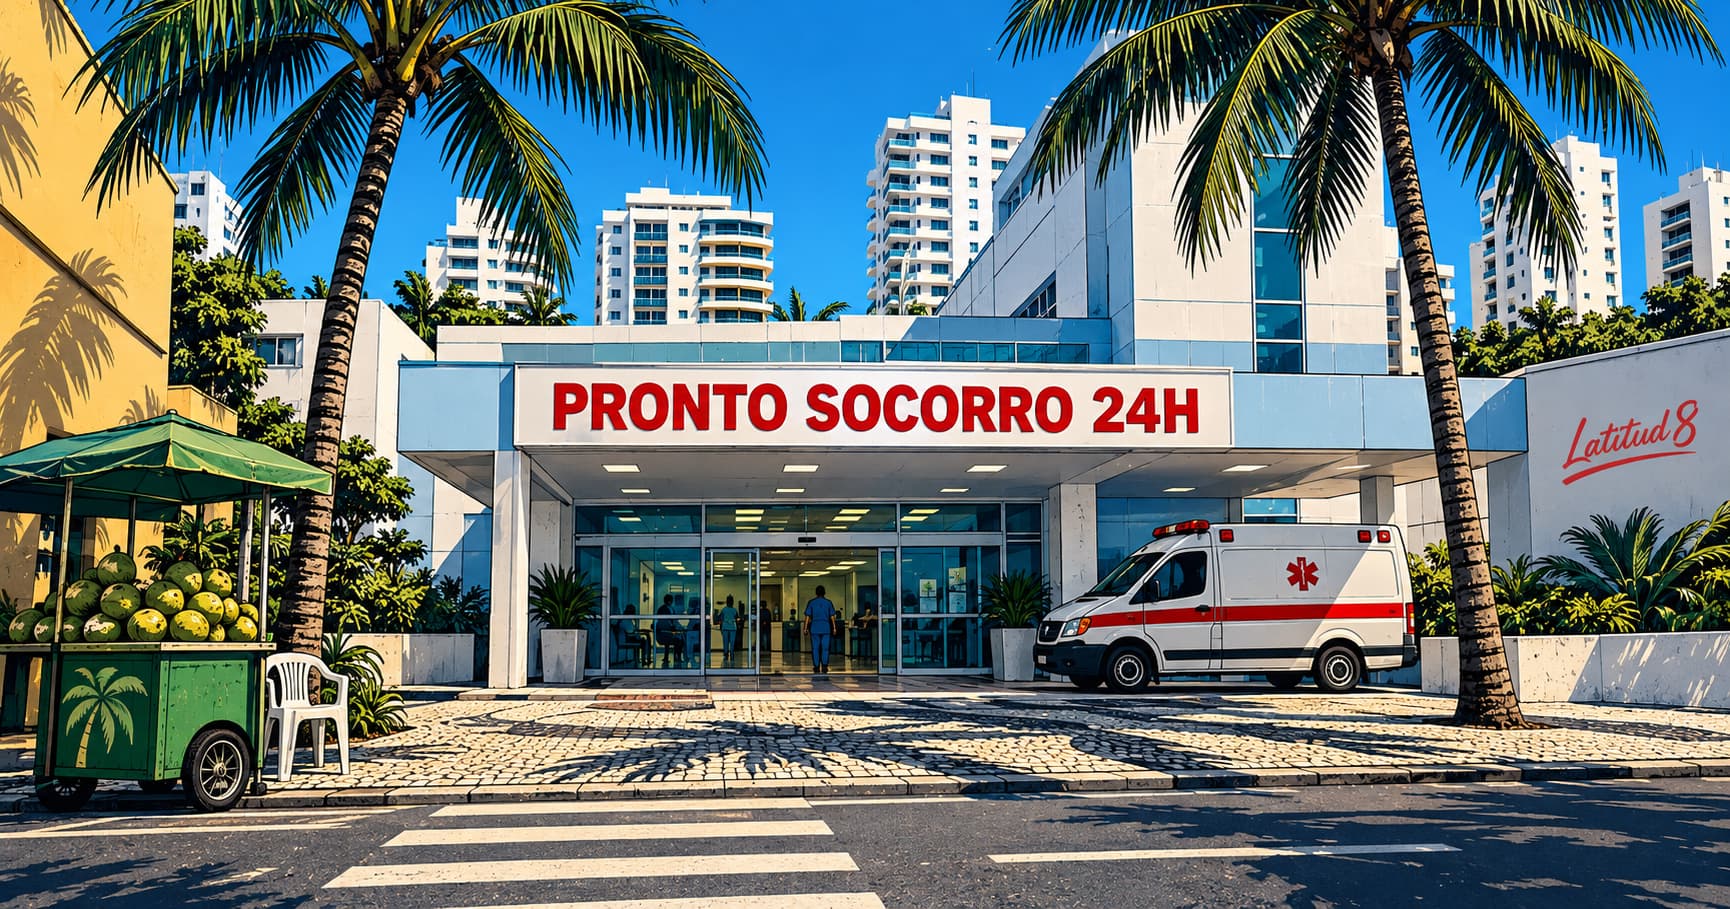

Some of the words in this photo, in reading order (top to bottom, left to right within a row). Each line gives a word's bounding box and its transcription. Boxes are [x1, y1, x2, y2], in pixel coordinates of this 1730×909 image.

[554, 382, 788, 431] PRONTO
[806, 383, 1073, 433] SOCORRO
[1093, 386, 1199, 433] 24H
